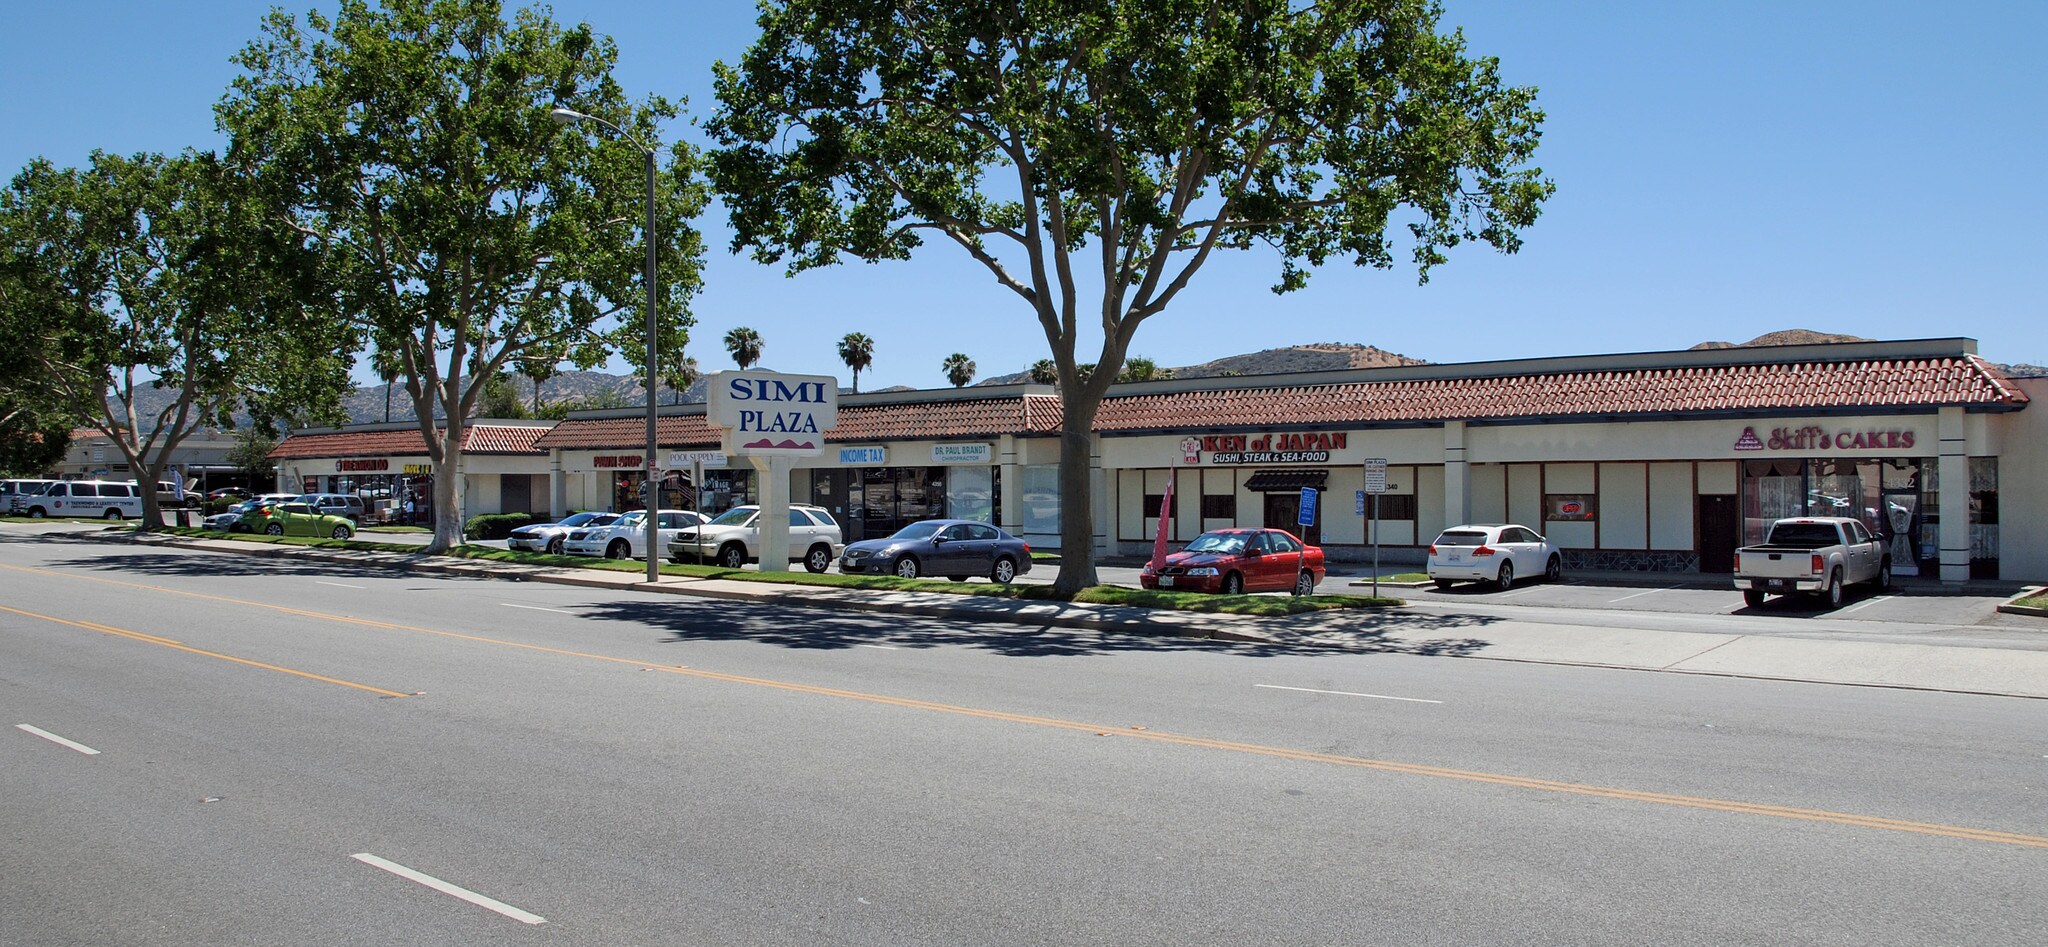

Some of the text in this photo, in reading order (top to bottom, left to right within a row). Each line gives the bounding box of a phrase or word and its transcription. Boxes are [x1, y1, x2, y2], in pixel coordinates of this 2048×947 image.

[730, 378, 827, 404] SIMI
[739, 410, 818, 434] PLAZA
[1203, 435, 1247, 452] KEN
[1251, 435, 1272, 452] of
[1276, 432, 1347, 451] JAPAN
[1768, 427, 1915, 450] Skiff's CAKES
[670, 453, 689, 462] POOL
[690, 452, 714, 462] SUPPLY
[840, 448, 884, 463] INCOME TAX
[946, 446, 961, 455] PAUL
[962, 445, 986, 454] BRANDT
[594, 455, 643, 468] PAWN SHOP
[1213, 452, 1327, 464] SUSHI, STEAK & SEA-FOOD
